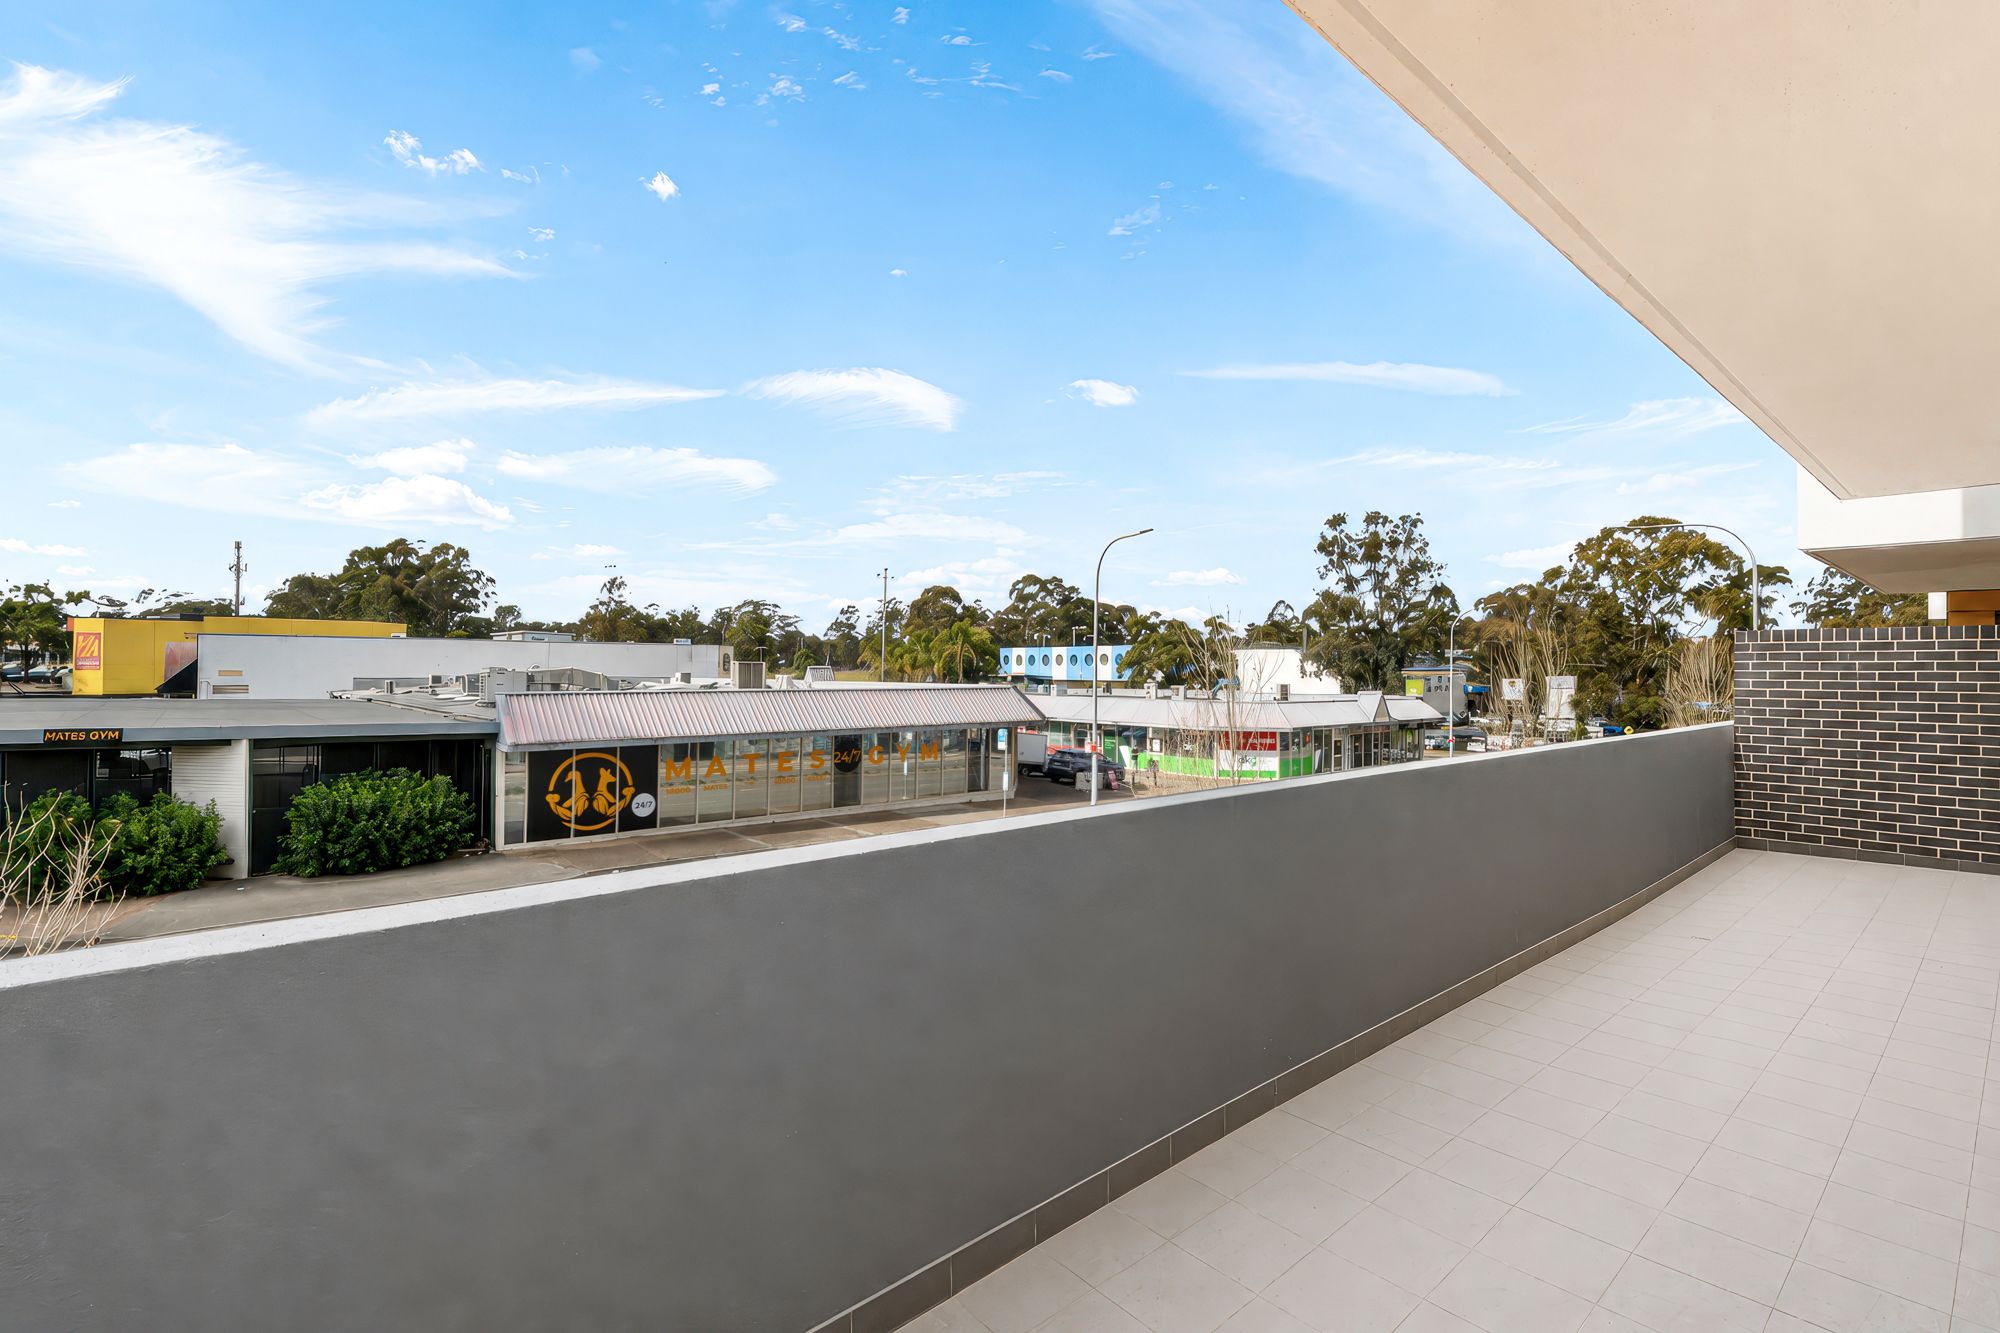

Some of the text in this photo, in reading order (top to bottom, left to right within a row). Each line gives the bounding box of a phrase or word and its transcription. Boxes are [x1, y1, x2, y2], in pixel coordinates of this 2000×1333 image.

[45, 731, 86, 742] MATES
[833, 748, 862, 765] 24/7
[634, 800, 653, 809] 24/7
